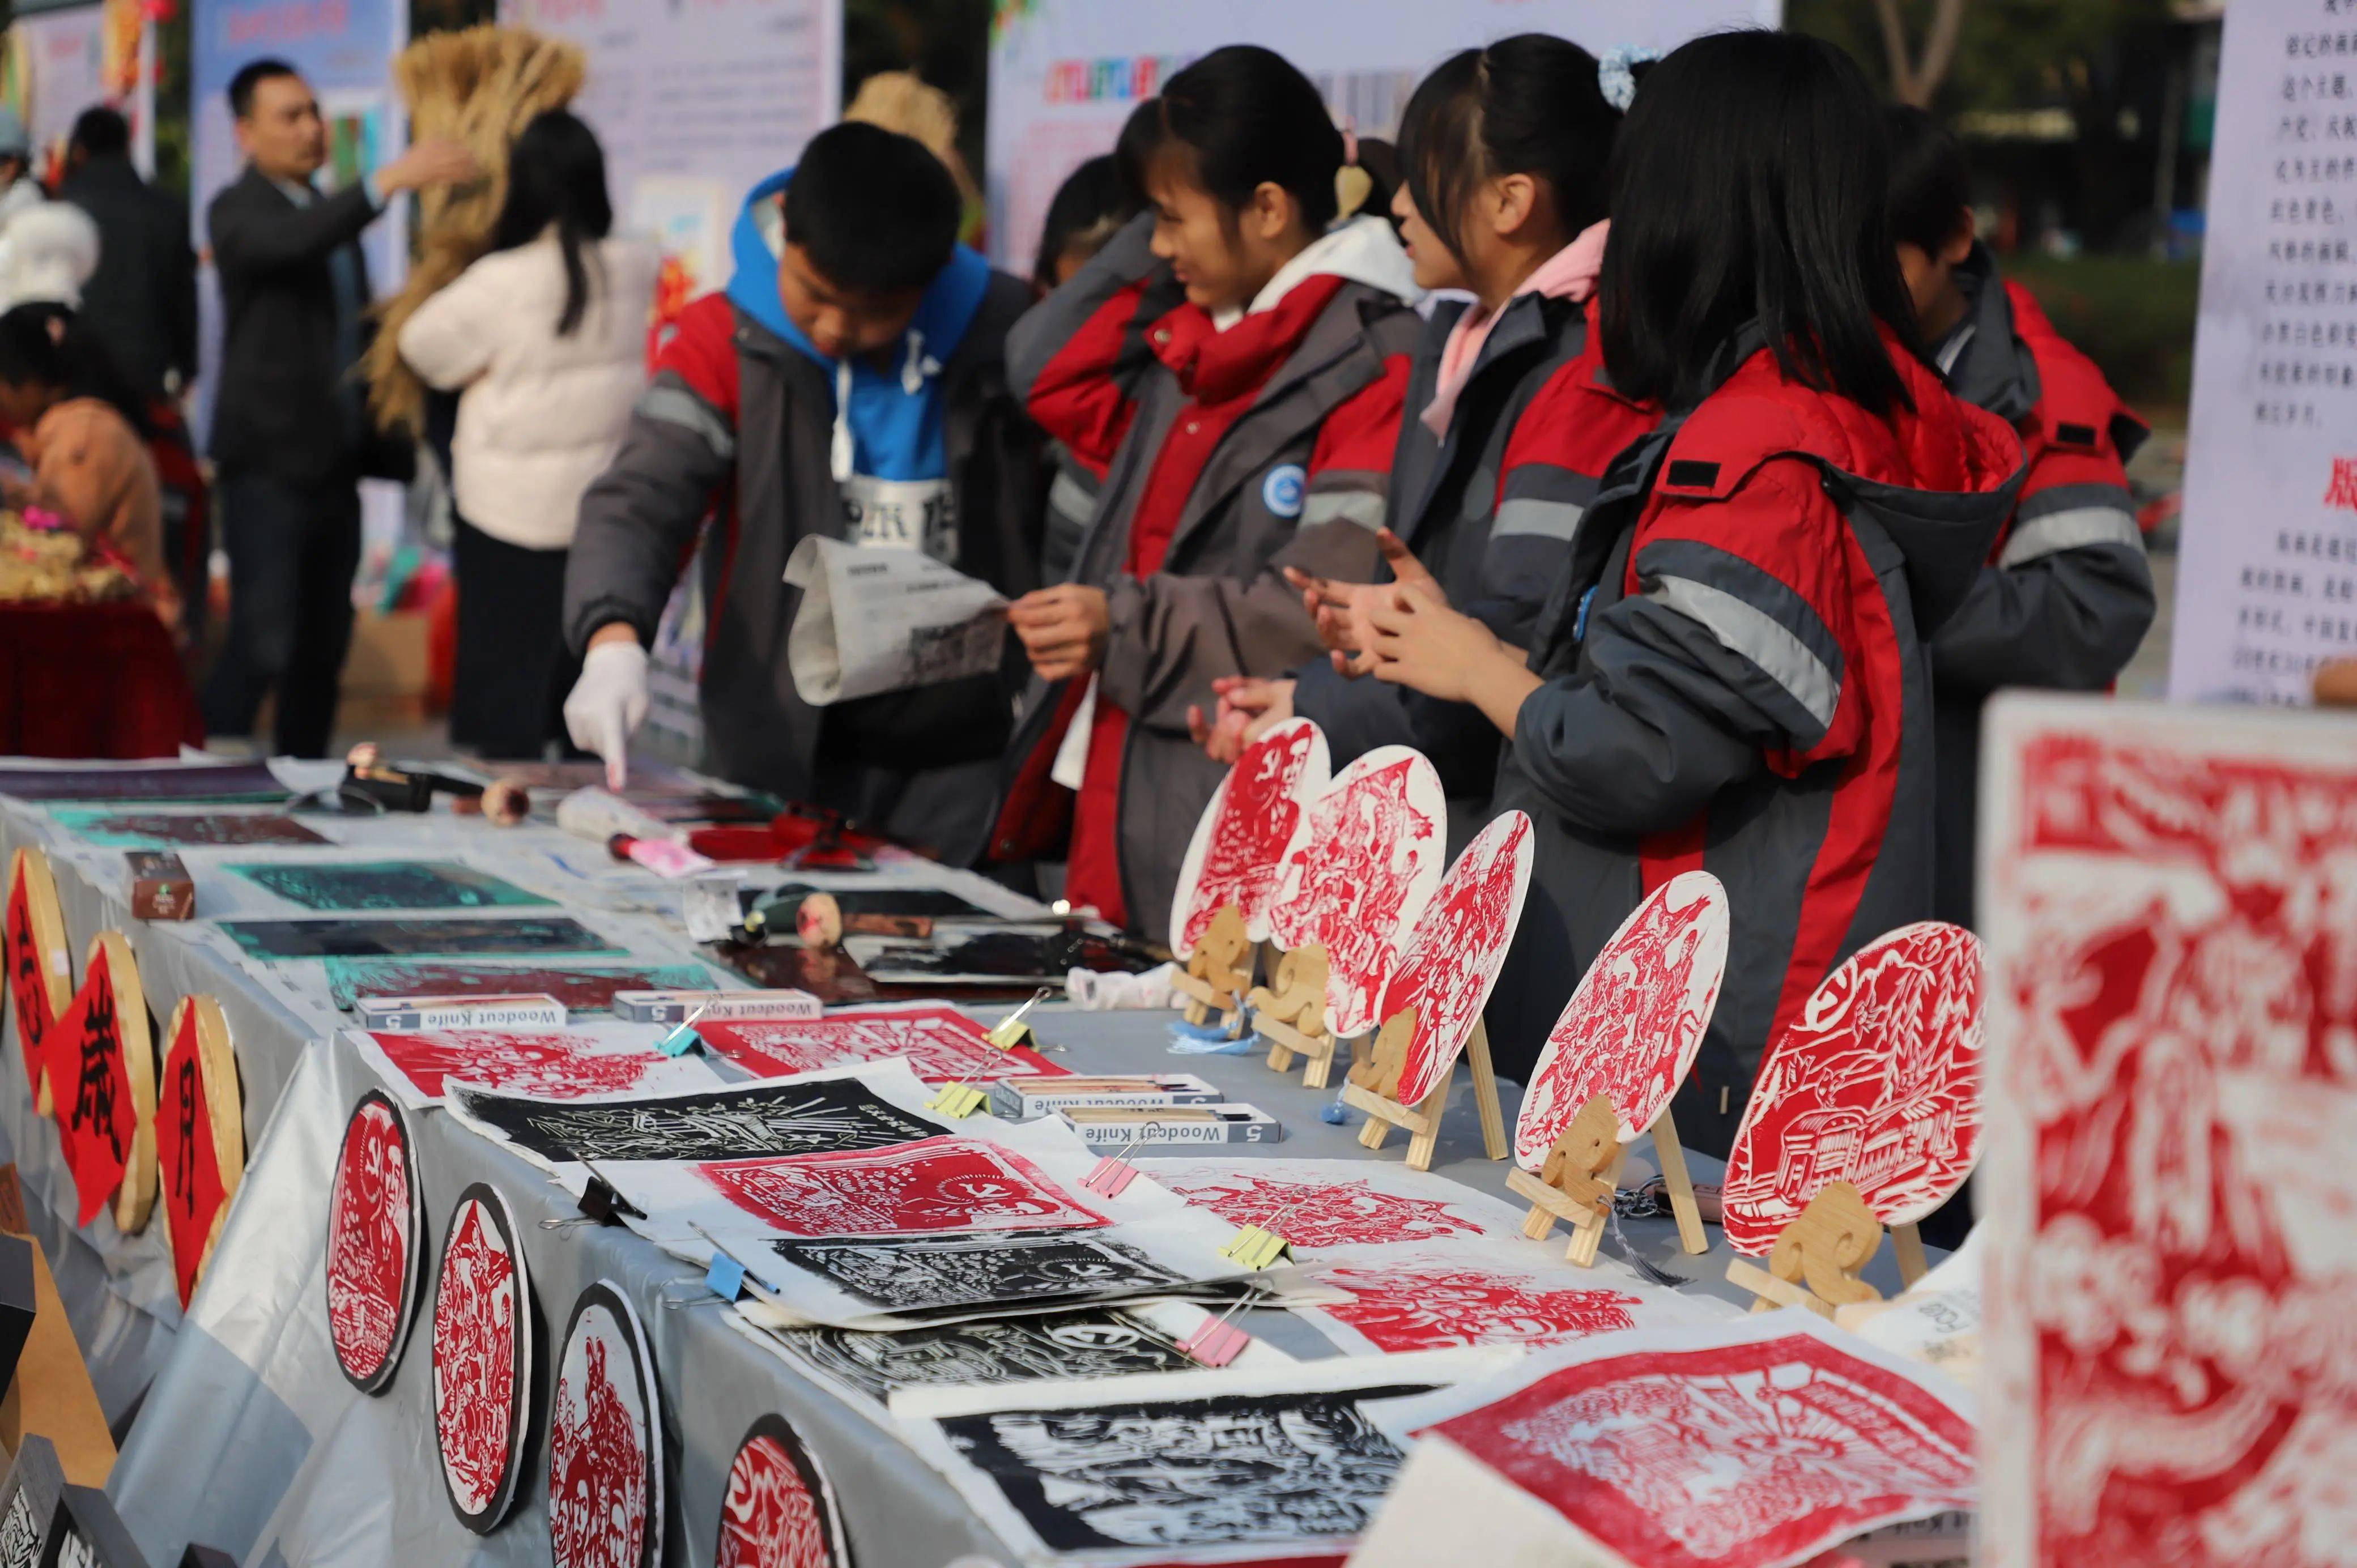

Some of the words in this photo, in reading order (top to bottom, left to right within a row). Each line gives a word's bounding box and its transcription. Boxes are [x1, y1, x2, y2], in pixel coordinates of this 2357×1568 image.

[479, 1009, 557, 1024] Woodcut
[739, 1003, 813, 1016] Woodcut
[428, 1009, 472, 1026] Knife
[175, 1056, 195, 1221] 月
[1086, 1127, 1131, 1142] Knife
[1139, 1127, 1220, 1141] Woodcut
[1246, 1124, 1263, 1142] 5
